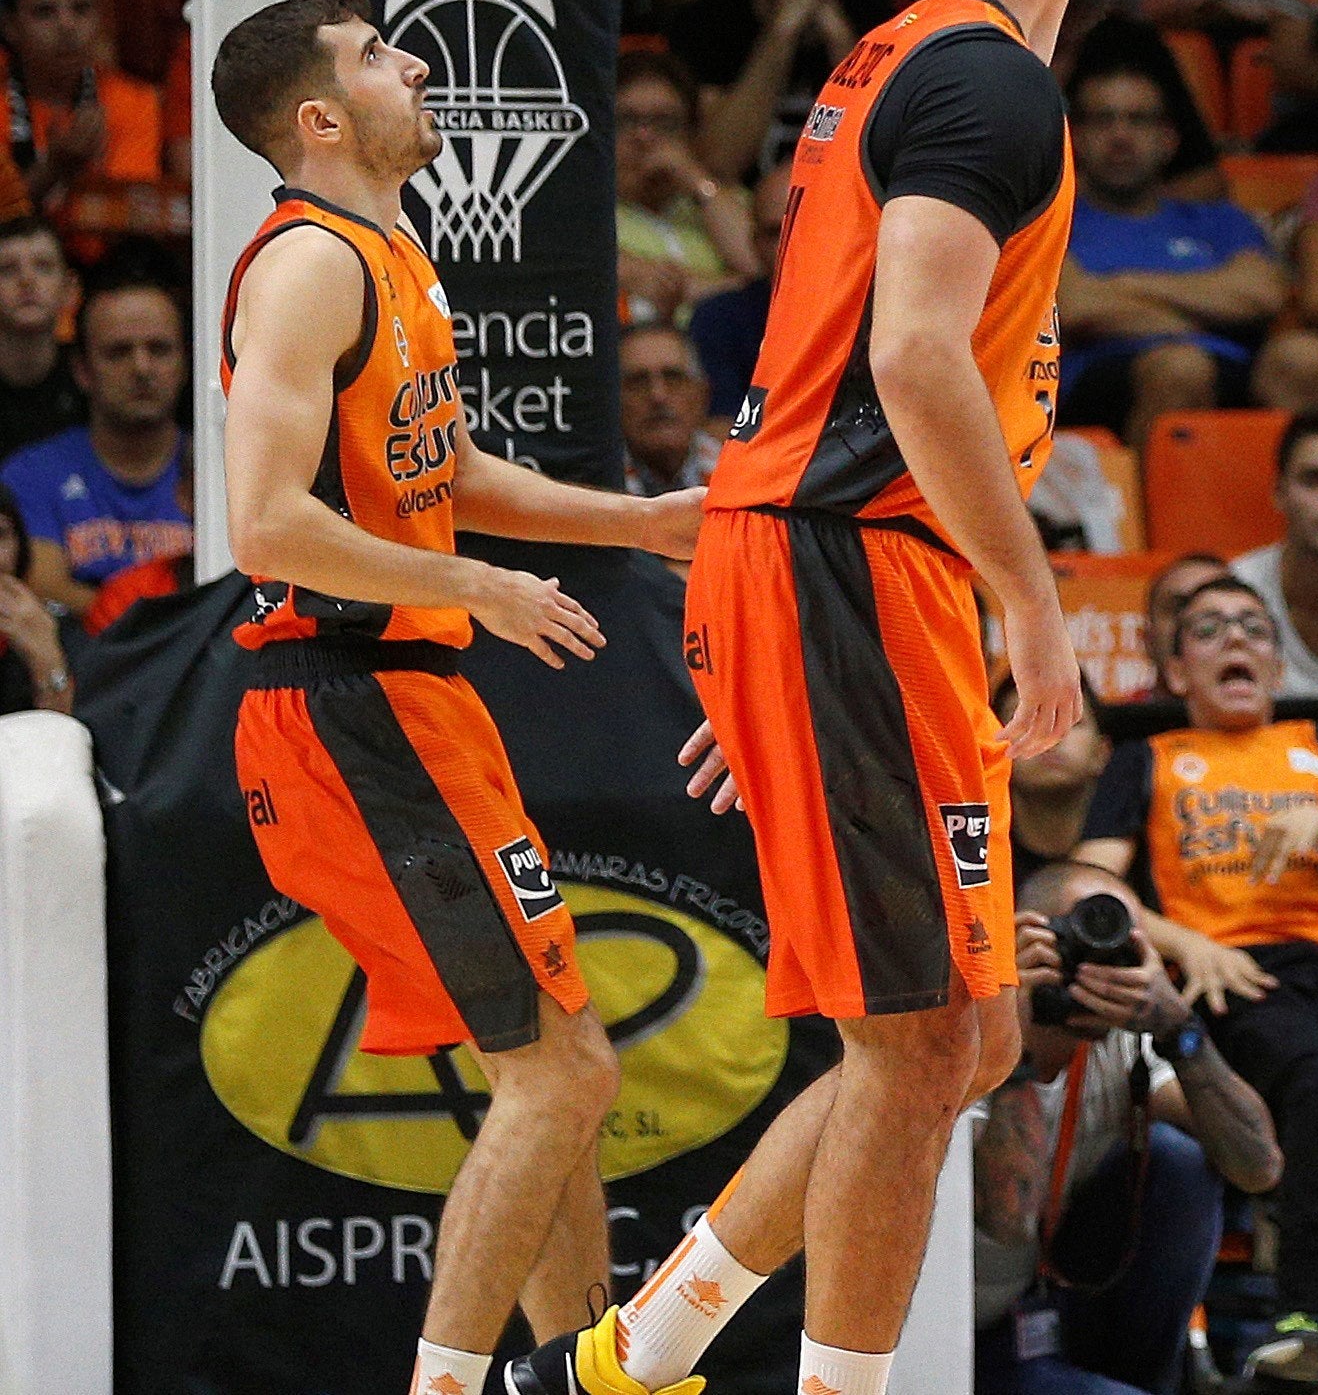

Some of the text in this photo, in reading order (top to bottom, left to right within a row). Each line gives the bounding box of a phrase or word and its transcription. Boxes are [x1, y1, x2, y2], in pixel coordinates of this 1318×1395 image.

[491, 109, 575, 131] BASKET
[451, 294, 594, 359] encia
[458, 367, 574, 433] sket
[551, 850, 670, 893] AMARAS
